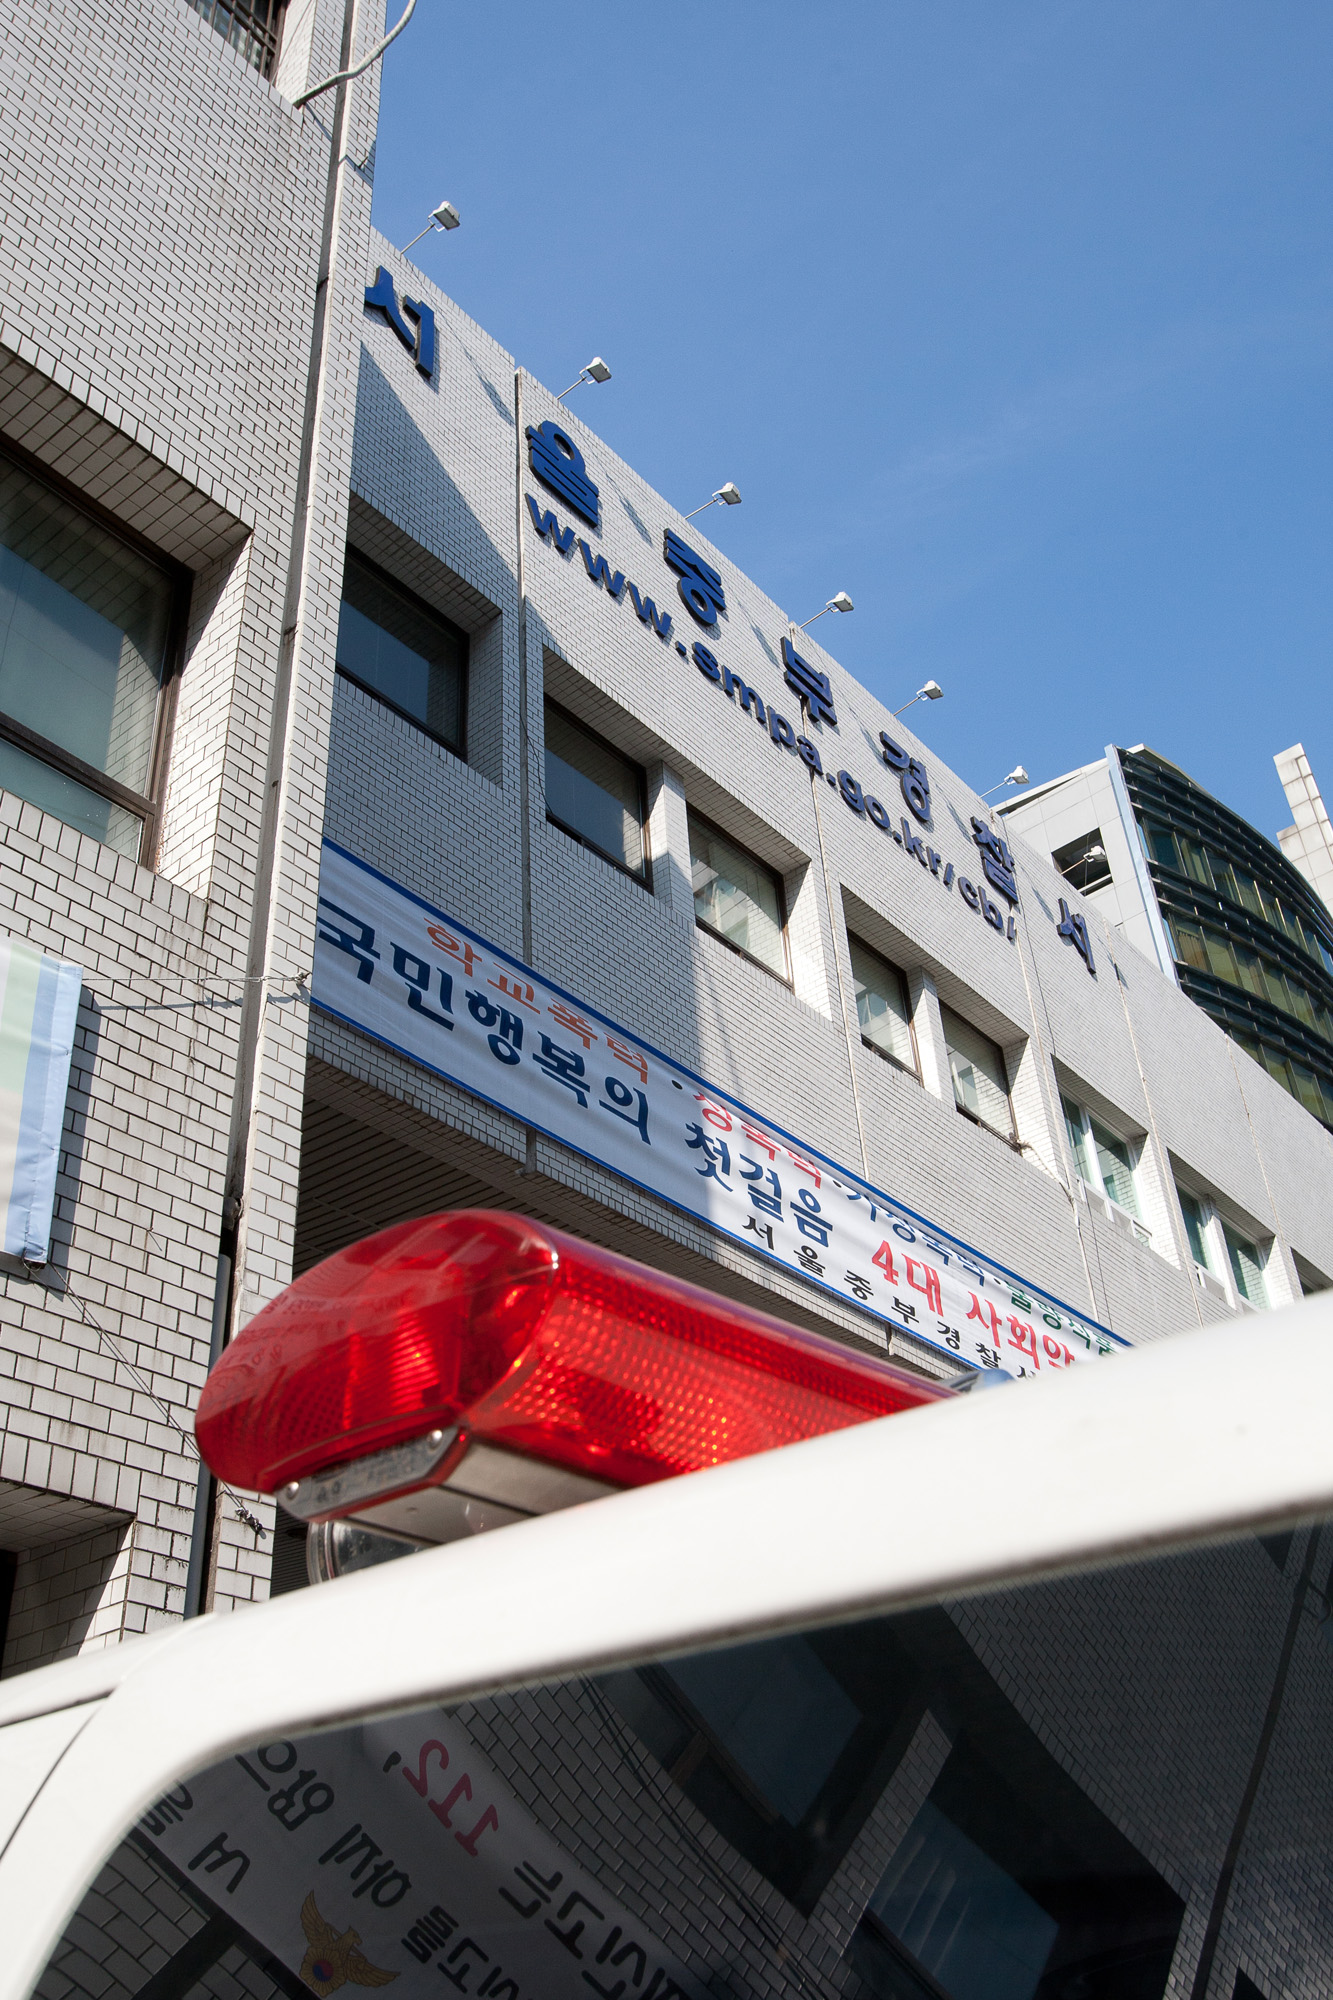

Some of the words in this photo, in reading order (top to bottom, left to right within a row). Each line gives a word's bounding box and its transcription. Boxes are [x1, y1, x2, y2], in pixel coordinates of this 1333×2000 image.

[316, 896, 651, 1146] 국민행복의
[685, 1122, 833, 1247] 첫걸음
[872, 1240, 944, 1318] 4대
